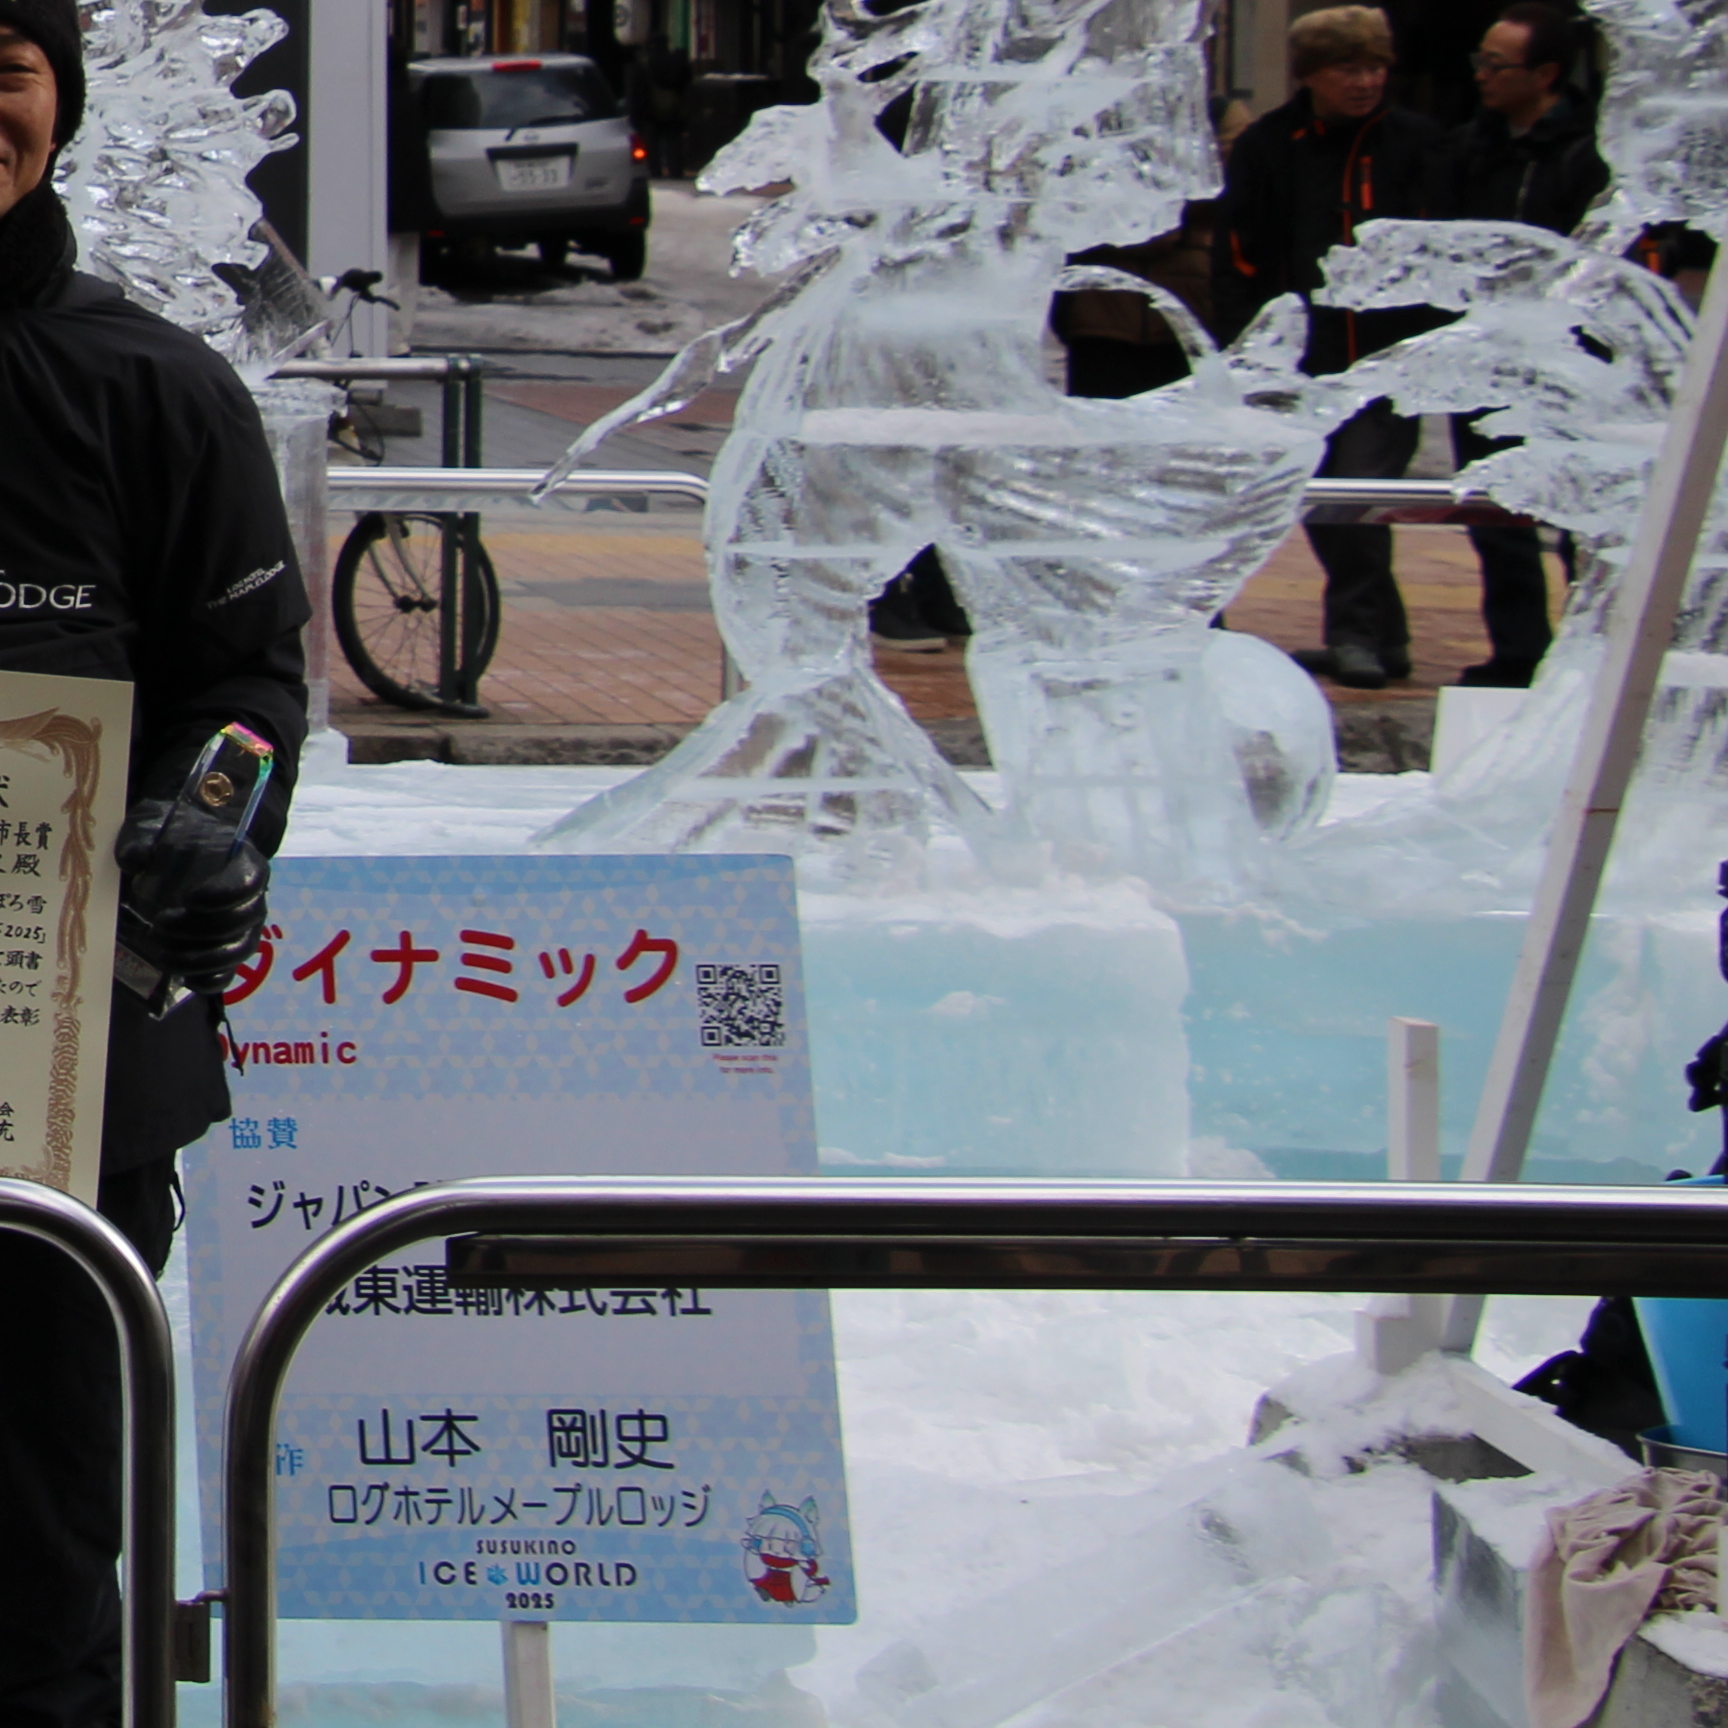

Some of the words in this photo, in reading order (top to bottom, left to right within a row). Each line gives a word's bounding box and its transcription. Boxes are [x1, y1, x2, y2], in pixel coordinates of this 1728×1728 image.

[223, 924, 679, 1008] ダイナミック
[229, 1117, 300, 1150] 協賛
[357, 1408, 482, 1468] 山本
[548, 1408, 675, 1469] 剛史
[328, 1483, 712, 1528] ログホテルメープルロッジ
[476, 1538, 577, 1556] SUSUKINO
[418, 1561, 478, 1587] ICE
[517, 1561, 637, 1587] WORLD
[505, 1592, 556, 1610] 2025
